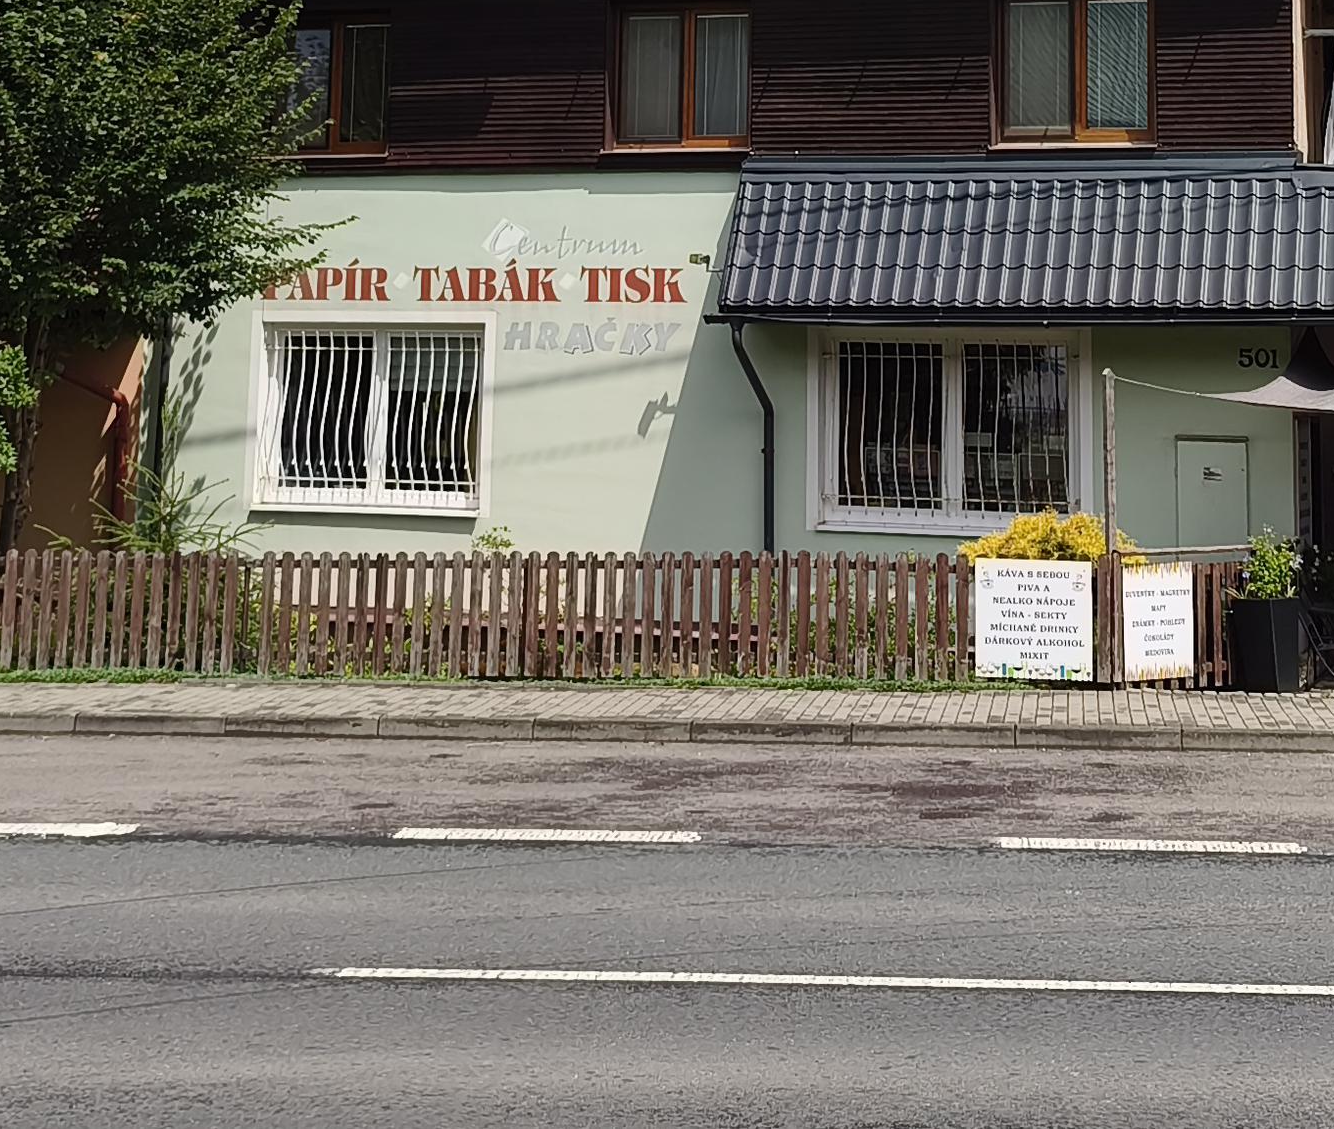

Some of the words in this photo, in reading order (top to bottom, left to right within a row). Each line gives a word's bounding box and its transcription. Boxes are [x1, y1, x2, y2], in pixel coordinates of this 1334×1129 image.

[490, 222, 644, 260] Centrum
[413, 258, 561, 302] TABÁK
[579, 265, 687, 303] TISK
[503, 317, 681, 355] HRAČKY
[1238, 347, 1279, 369] 501
[997, 568, 1024, 578] KÁVA
[1017, 584, 1040, 592] PIVA
[992, 596, 1033, 605] NEALKO
[1036, 596, 1076, 606] NÁPOJE
[1001, 608, 1025, 618] VÍNA
[1034, 611, 1068, 620] SEKTY
[990, 622, 1037, 633] MÍCHANÉ
[1040, 624, 1079, 634] DRINKY
[984, 635, 1033, 646] DÁRKOVÝ
[1036, 638, 1085, 647] ALKOHOL
[1020, 652, 1050, 660] MIXIT
